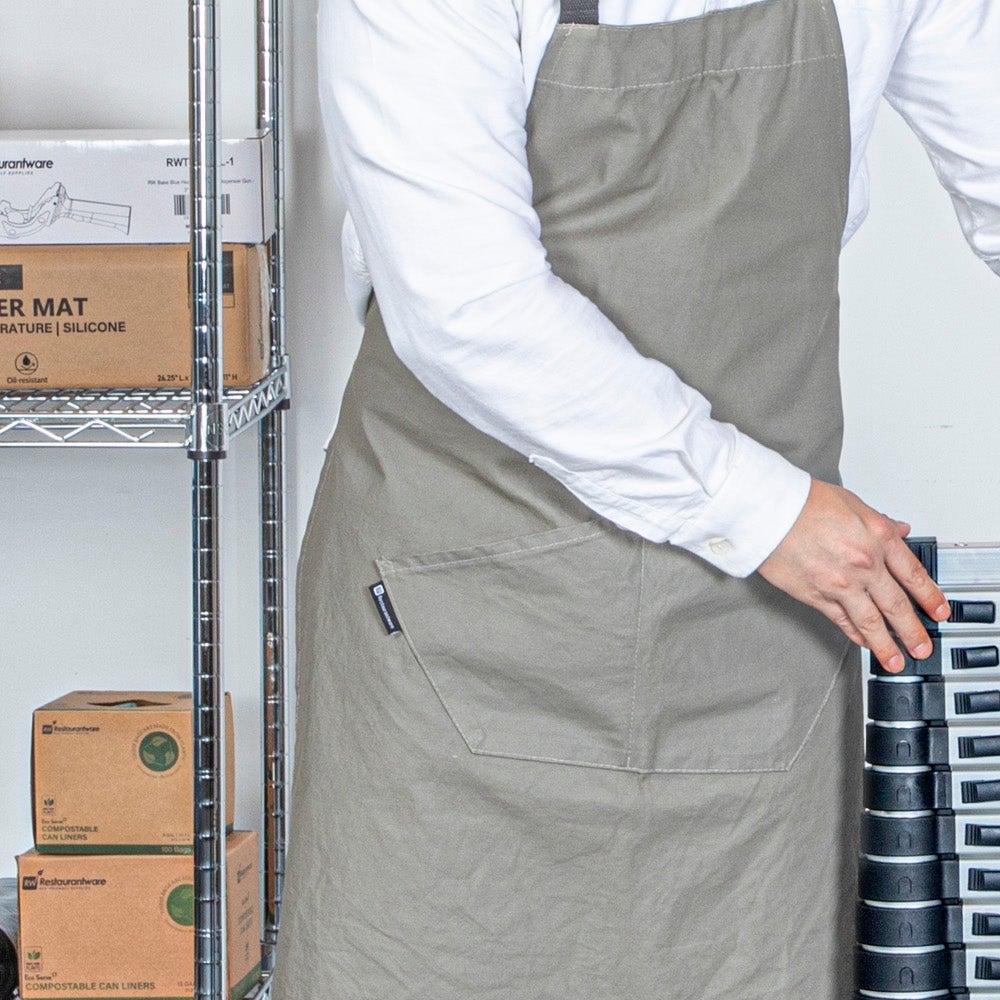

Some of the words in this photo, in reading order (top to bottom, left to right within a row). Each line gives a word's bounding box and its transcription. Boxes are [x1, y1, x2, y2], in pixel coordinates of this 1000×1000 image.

[0, 298, 25, 317] ER
[33, 297, 88, 317] MAT
[0, 323, 52, 334] RATURE
[63, 321, 126, 333] SILICONE
[6, 376, 48, 384] Oil-resistant
[40, 877, 107, 886] Restaurantware
[25, 982, 96, 991] COMPOSTABLE
[99, 982, 119, 990] CAN
[122, 982, 156, 990] LINERS
